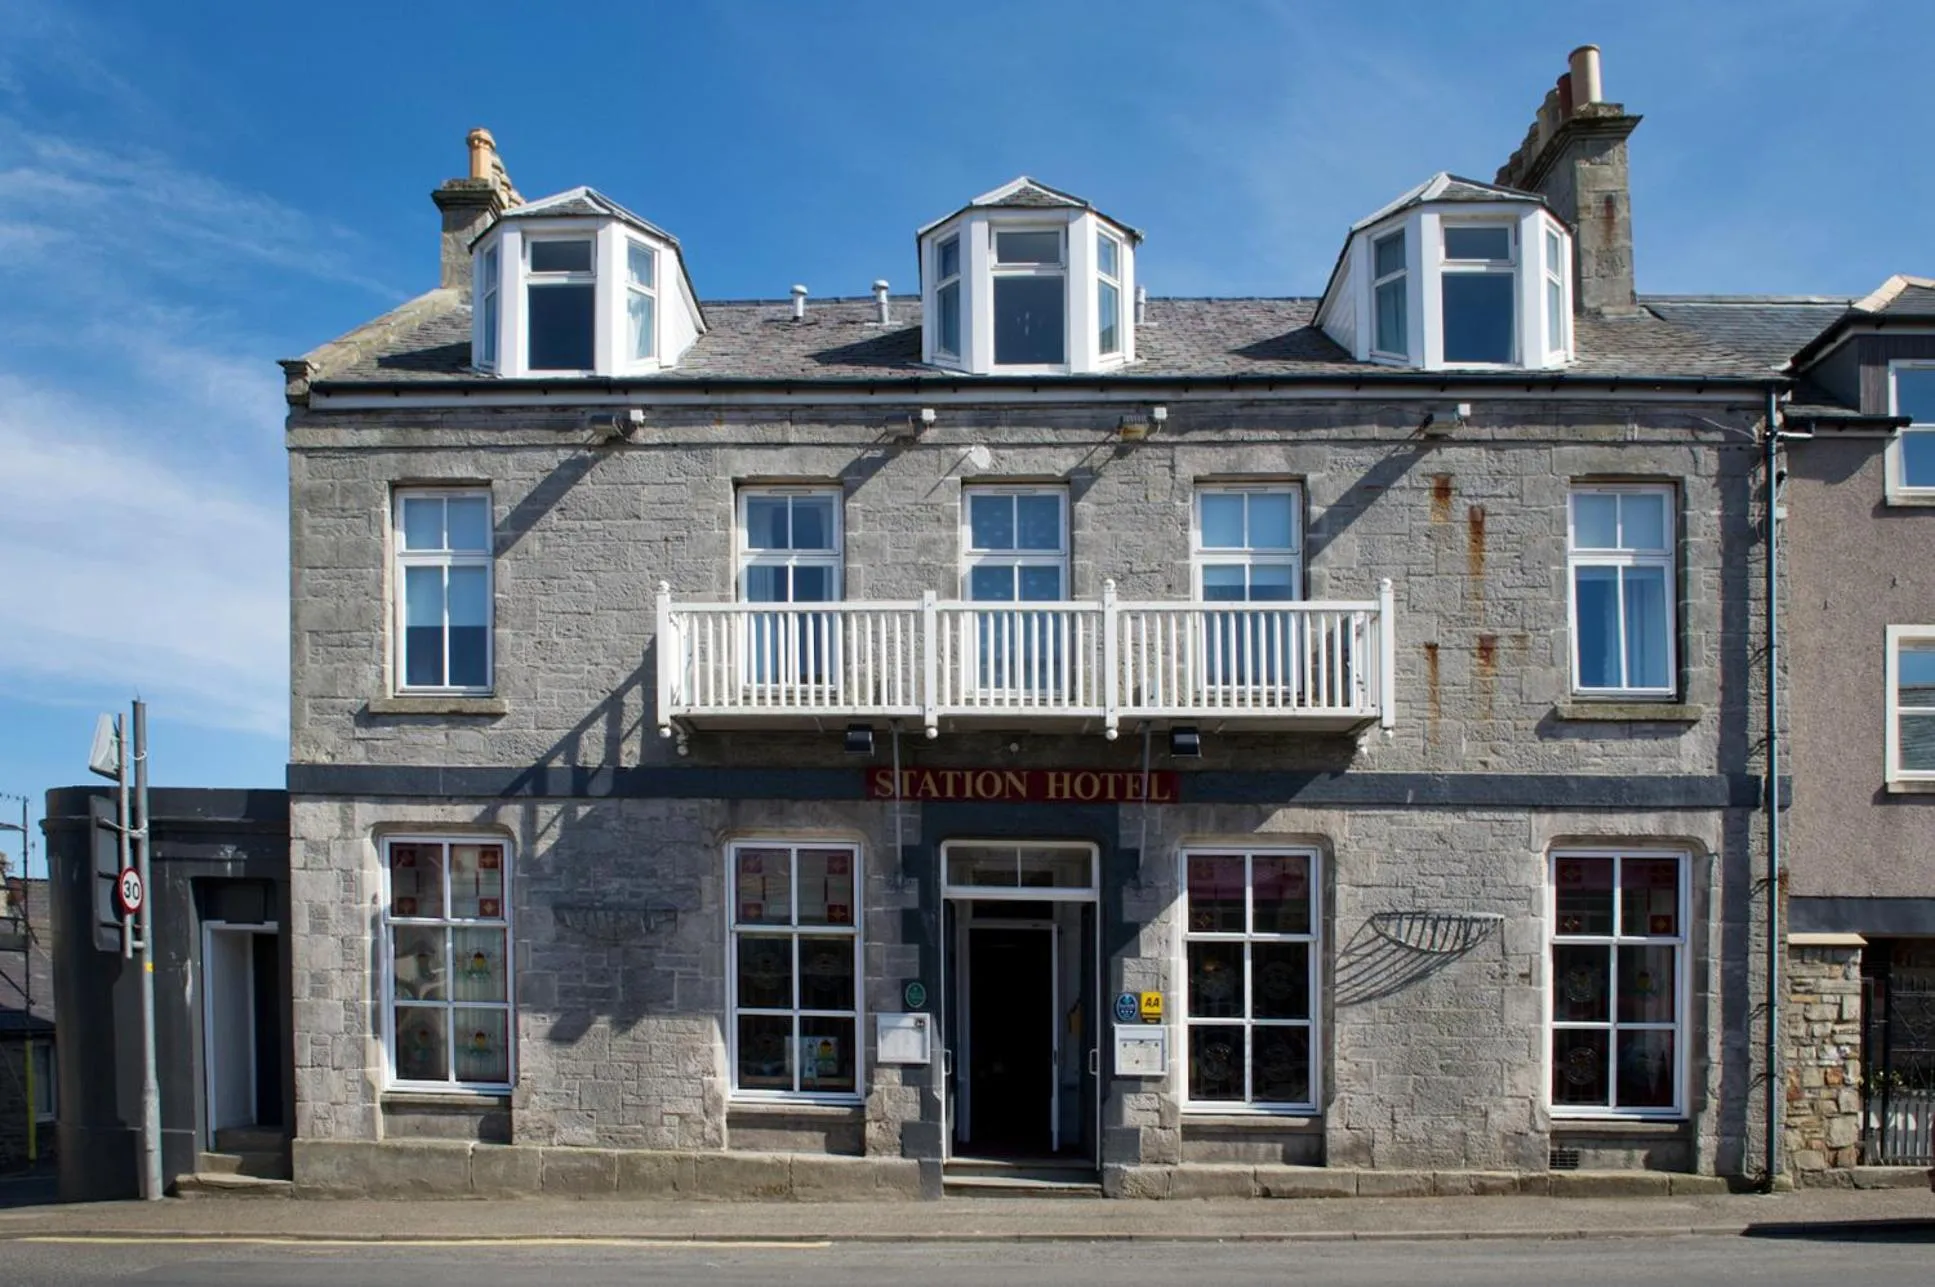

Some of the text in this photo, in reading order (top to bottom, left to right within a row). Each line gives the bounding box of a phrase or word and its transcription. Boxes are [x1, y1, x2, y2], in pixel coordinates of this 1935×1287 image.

[874, 770, 1171, 800] STATION HOTEL
[124, 881, 139, 900] 30
[1145, 997, 1160, 1007] AA
